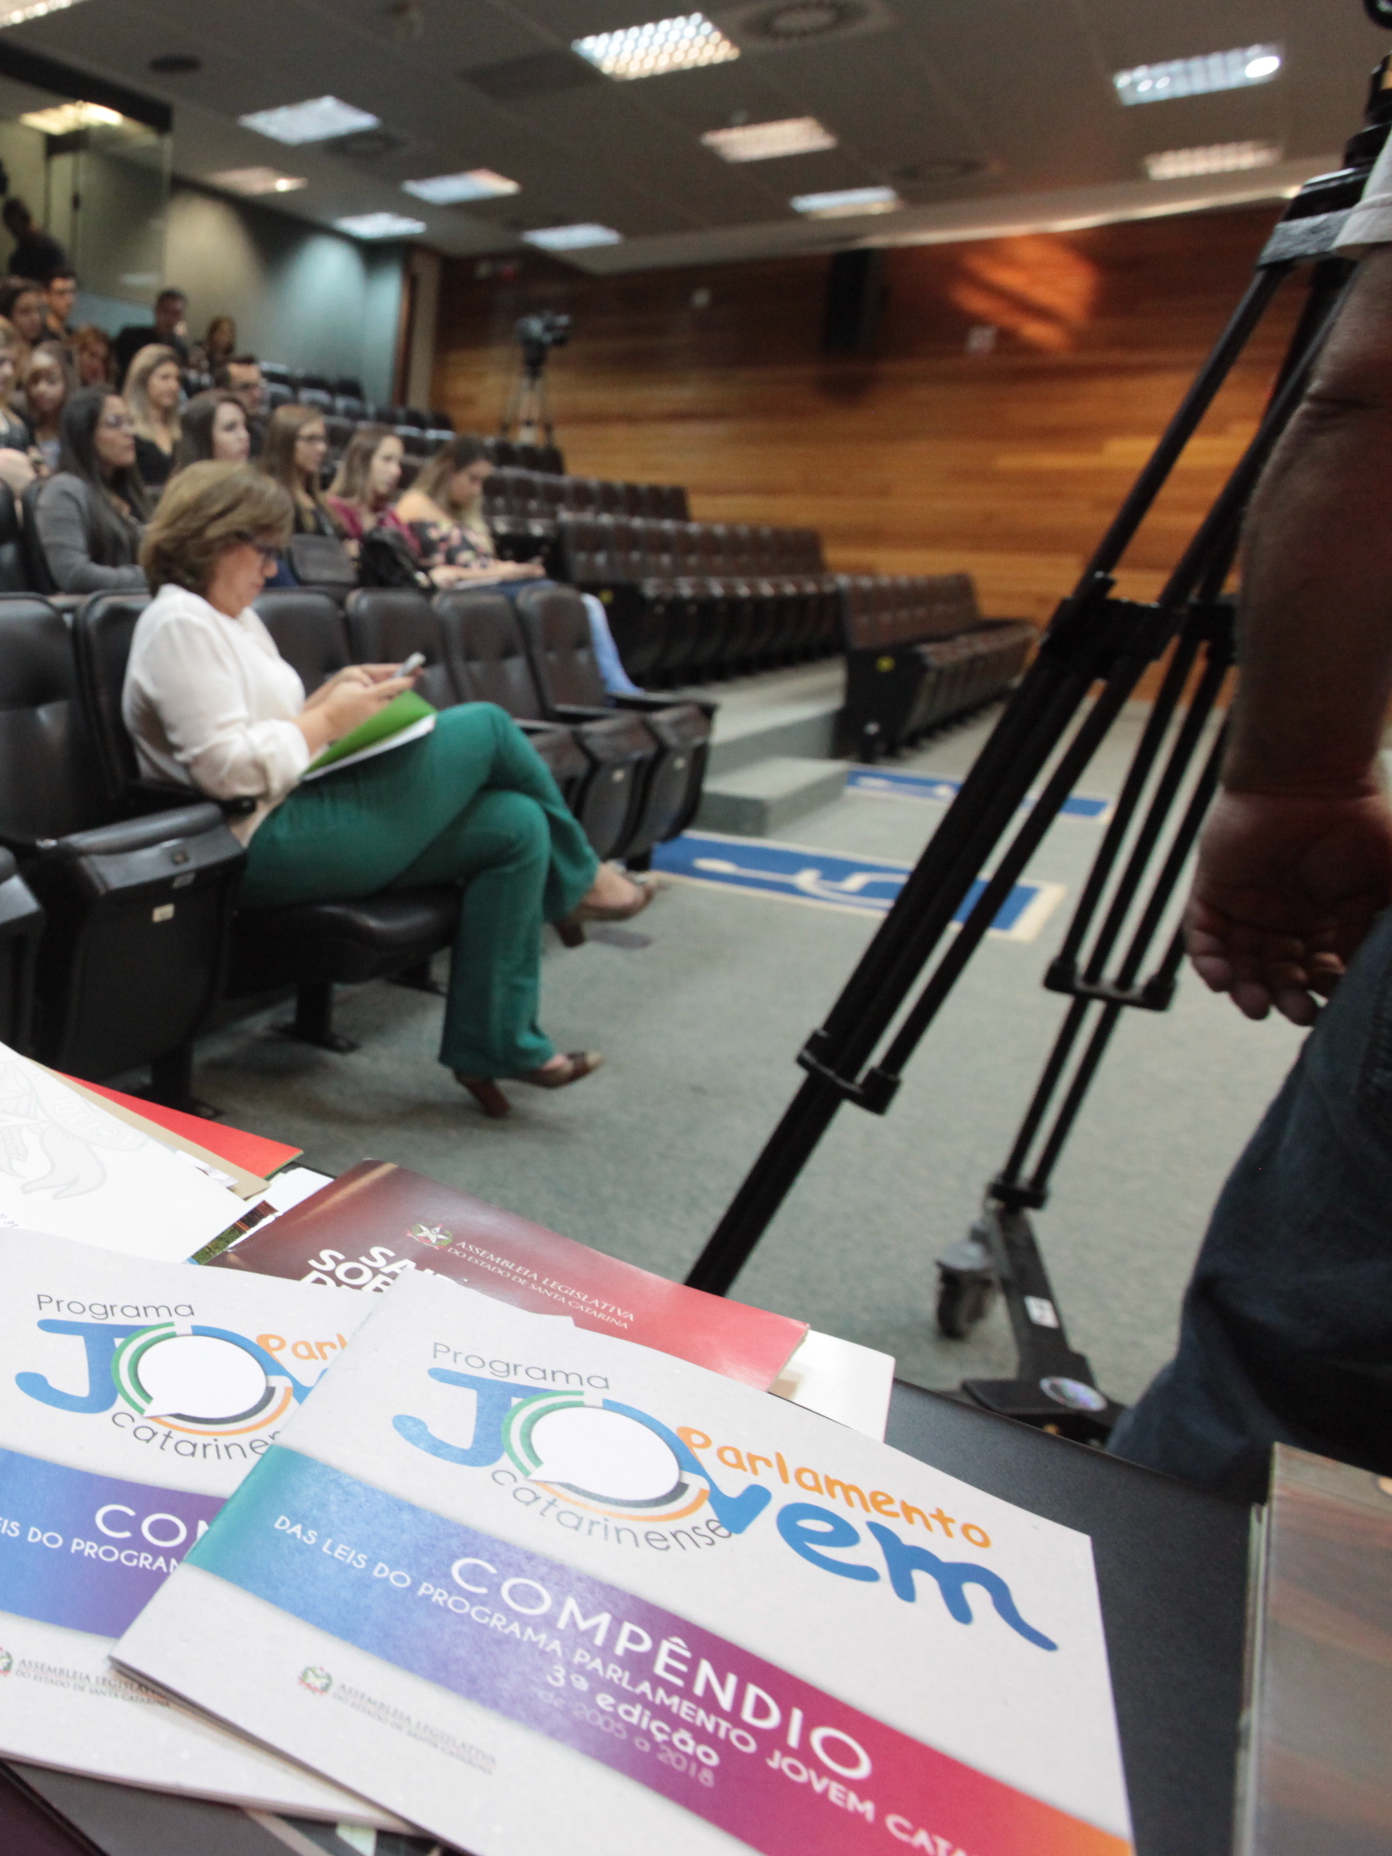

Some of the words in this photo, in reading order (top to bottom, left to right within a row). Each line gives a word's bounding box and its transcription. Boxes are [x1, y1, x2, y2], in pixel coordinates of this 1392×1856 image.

[36, 1294, 194, 1320] Programa
[447, 1246, 468, 1261] DO
[467, 1254, 511, 1278] ESTADO
[512, 1274, 530, 1287] DE
[529, 1283, 567, 1304] SANTA
[568, 1299, 628, 1329] CATARINA
[456, 1241, 538, 1280] ASSEMBLEIA
[542, 1276, 634, 1322] LEGISLATIVA
[433, 1341, 610, 1391] Programa
[676, 1426, 992, 1549] Parlamento
[27, 1527, 63, 1548] DO
[15, 1669, 31, 1679] DO
[33, 1674, 70, 1690] ESTADO
[72, 1683, 85, 1693] DE
[88, 1686, 119, 1700] SANTA
[19, 1659, 91, 1685] ASSEMBLEIA
[274, 1515, 318, 1545] DAS
[322, 1538, 368, 1569] LEIS
[373, 1563, 411, 1588] DO
[417, 1582, 563, 1657] PROGRAMA
[573, 1648, 758, 1753] PARLAMENTO
[766, 1750, 876, 1823] JOVEM
[451, 1557, 873, 1781] COMPÊNDIO
[339, 1683, 412, 1725] ASSEMBLEIA
[415, 1720, 497, 1766] LEGISLATIVA
[595, 1691, 721, 1768] edição
[634, 1735, 652, 1752] a
[656, 1743, 716, 1788] 2018
